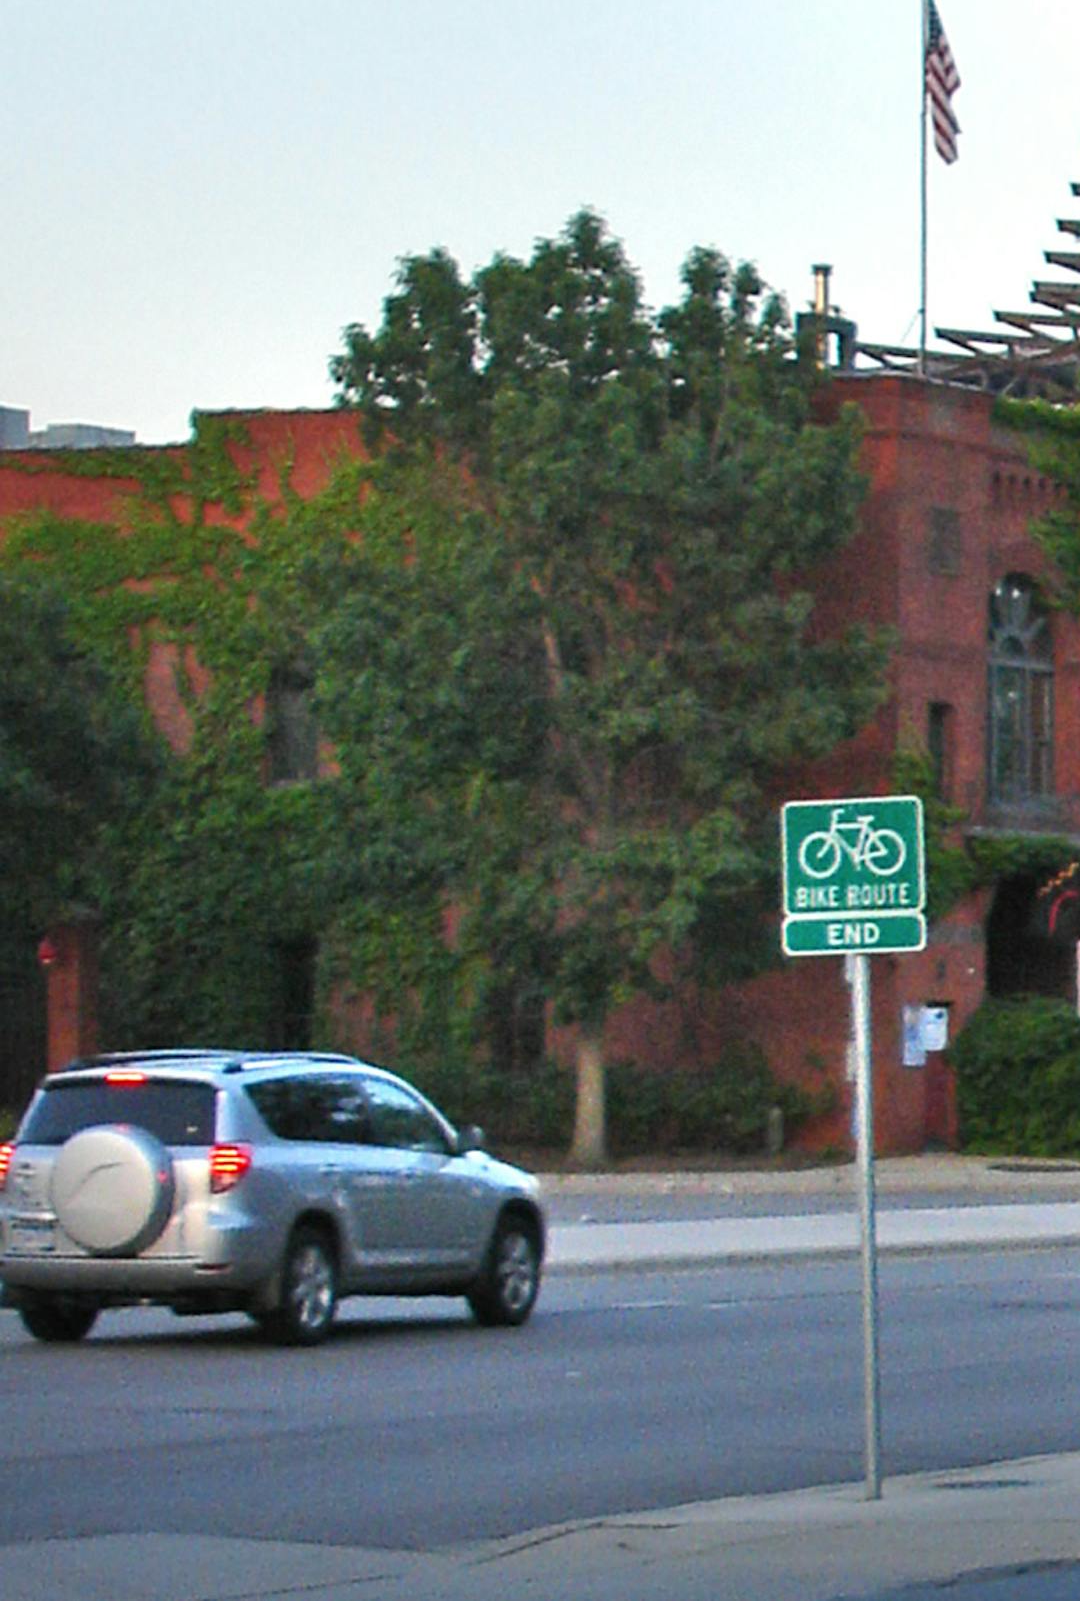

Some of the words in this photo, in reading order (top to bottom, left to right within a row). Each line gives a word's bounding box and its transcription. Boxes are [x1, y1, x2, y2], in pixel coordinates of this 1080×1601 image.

[796, 885, 839, 908] BIKE
[846, 882, 911, 906] ROUTE
[827, 922, 880, 946] END
